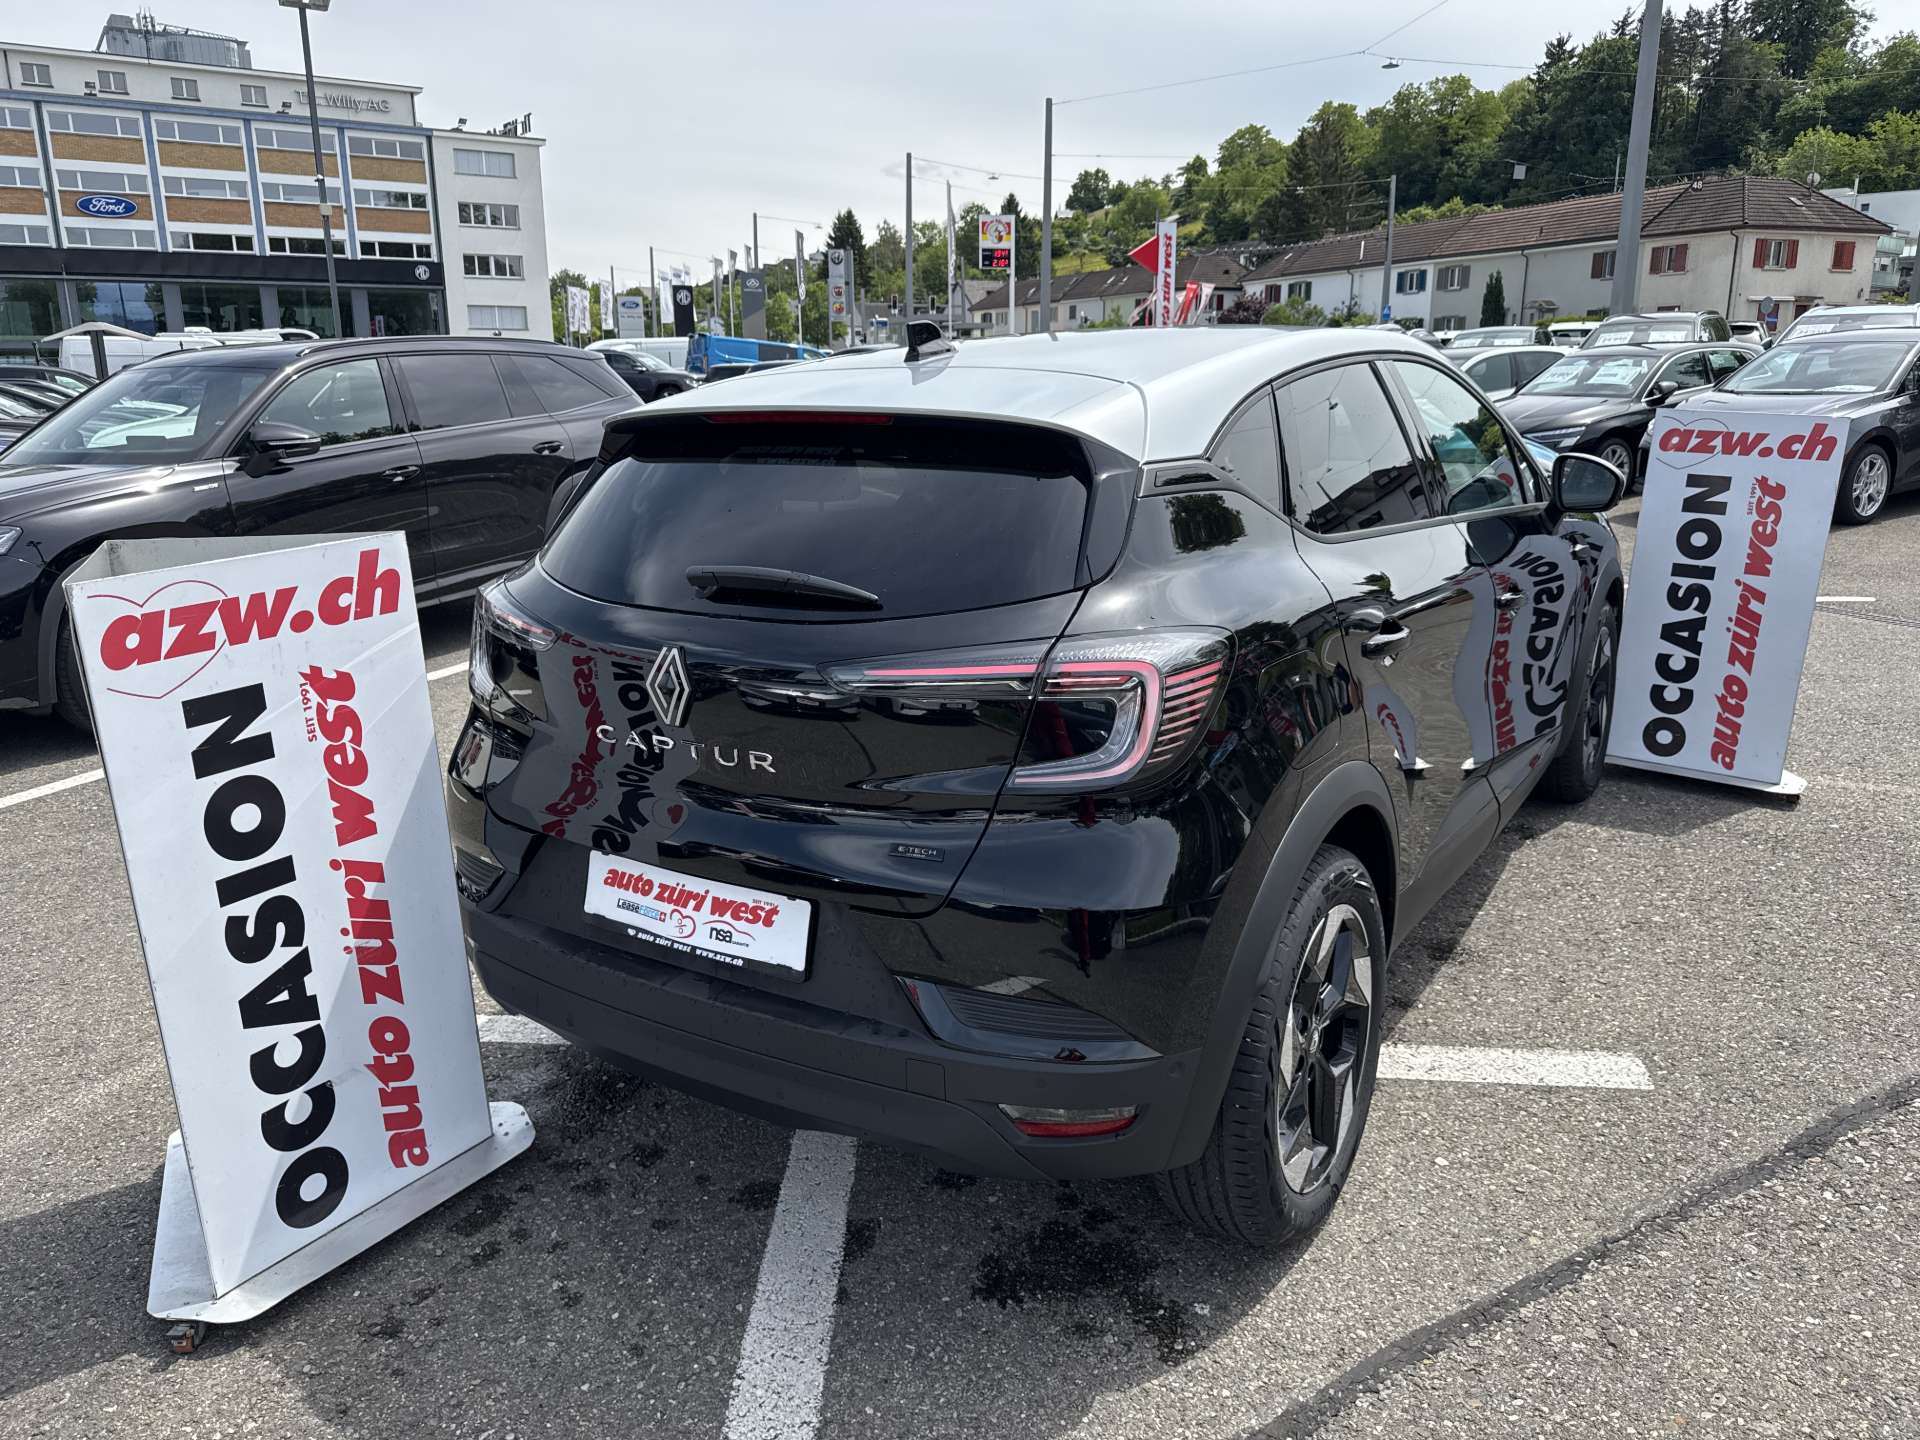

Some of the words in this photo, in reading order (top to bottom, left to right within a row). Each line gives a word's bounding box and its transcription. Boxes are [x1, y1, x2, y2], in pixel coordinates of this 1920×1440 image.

[325, 93, 364, 112] Willy
[367, 97, 391, 113] AG
[89, 197, 126, 213] Ford
[1692, 180, 1703, 189] 48
[1163, 232, 1173, 269] west
[676, 290, 691, 305] MG
[1659, 422, 1838, 461] azw.ch
[1743, 475, 1787, 577] west
[100, 548, 401, 671] azw.ch
[1642, 473, 1733, 757] OCCASION
[1725, 578, 1767, 677] züri
[299, 682, 313, 713] 1991
[1710, 674, 1749, 771] auto
[304, 716, 318, 743] SEIT
[596, 724, 777, 774] CAPTUR
[297, 665, 377, 847] west
[603, 868, 654, 897] auto
[653, 882, 710, 912] züri
[710, 896, 780, 928] west
[181, 682, 350, 1230] OCCASION
[328, 858, 406, 1006] züri
[637, 932, 654, 943] auto
[655, 937, 673, 948] züri
[673, 943, 692, 953] west
[695, 948, 744, 967] www.azw.ch
[709, 926, 733, 944] nsa
[363, 1014, 431, 1170] auto
